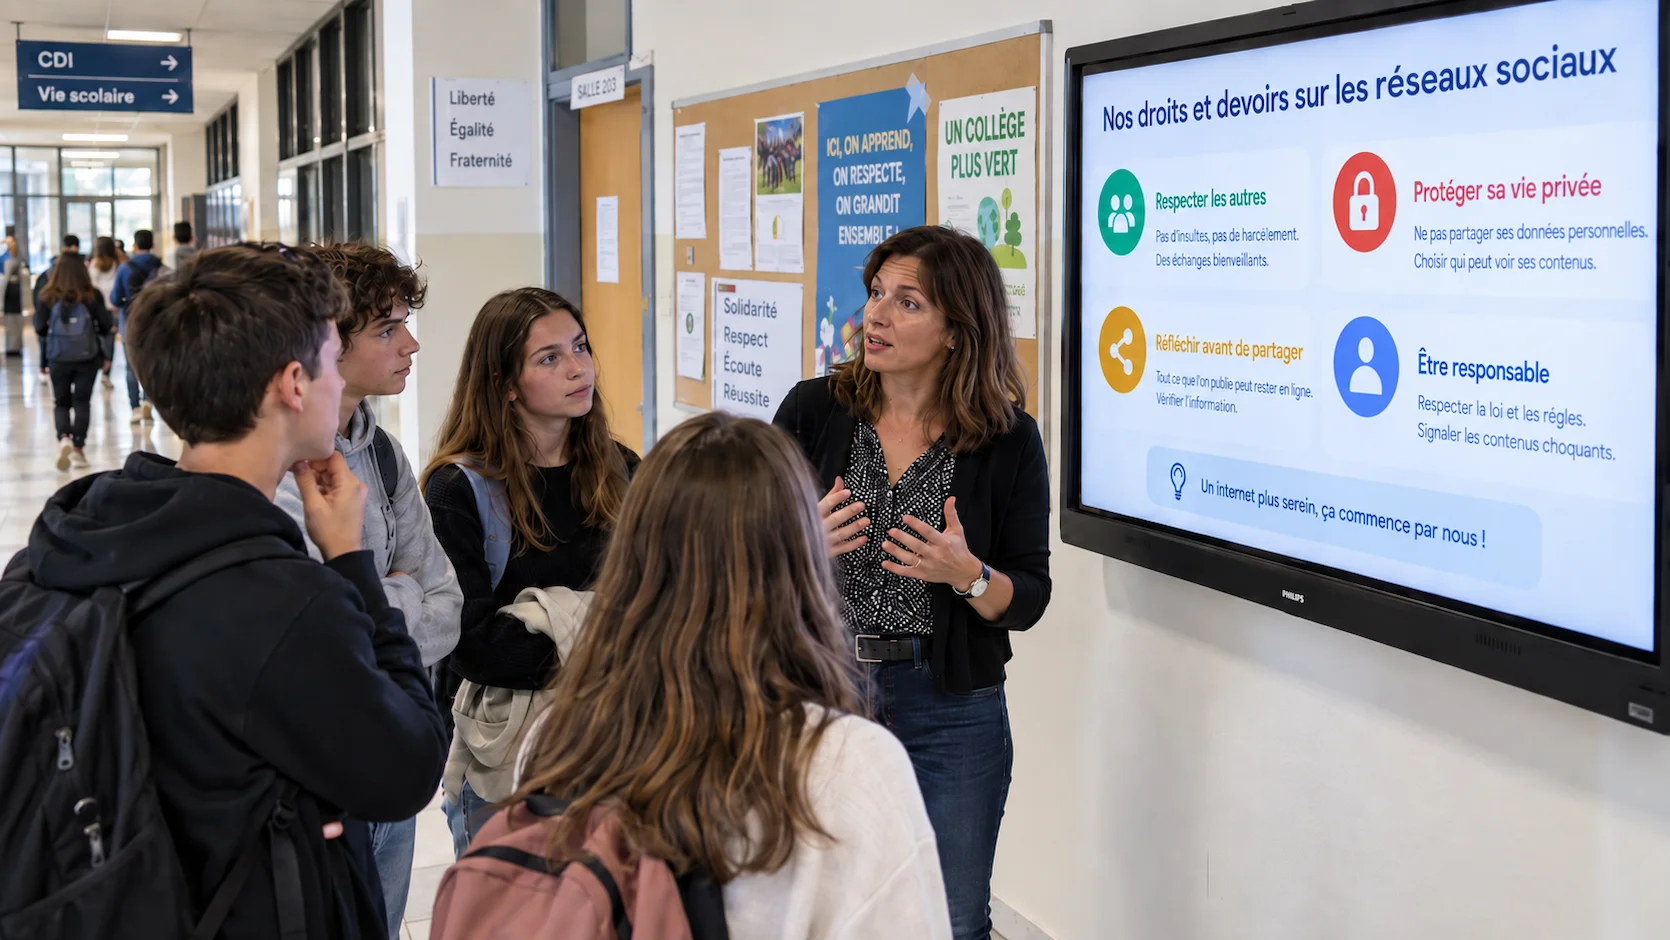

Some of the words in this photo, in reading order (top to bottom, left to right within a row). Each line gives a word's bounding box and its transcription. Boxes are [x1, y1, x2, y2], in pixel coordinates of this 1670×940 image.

[37, 51, 73, 69] CDI
[37, 86, 66, 103] Vie
[70, 87, 135, 104] scolaire
[449, 90, 495, 106] Liberté
[578, 80, 600, 99] SALLE
[602, 77, 617, 94] 203
[1103, 105, 1133, 132] Nos
[1138, 97, 1188, 127] droits
[1193, 95, 1212, 121] et
[1216, 84, 1289, 119] devoirs
[1295, 84, 1329, 109] sur
[1336, 73, 1369, 105] les
[1375, 64, 1488, 100] réseaux
[1496, 43, 1617, 85] sociaux
[449, 118, 494, 140] Égalité
[945, 119, 963, 145] UN
[965, 107, 1026, 143] COLLÈGE
[826, 137, 842, 159] ICI,
[844, 134, 861, 155] ON
[861, 128, 914, 153] APPREND,
[449, 152, 513, 168] Fraternité
[951, 152, 982, 179] PLUS
[984, 148, 1018, 177] VERT
[833, 167, 848, 186] ON
[850, 161, 906, 185] RESPECTE,
[1155, 191, 1208, 213] Respecter
[1211, 188, 1227, 207] les
[1229, 188, 1267, 206] autres
[1414, 179, 1482, 208] Protéger
[1487, 183, 1506, 200] sa
[1511, 176, 1537, 199] vie
[1541, 172, 1602, 205] privée
[836, 196, 852, 215] ON
[853, 194, 901, 214] GRANDIT
[1155, 229, 1170, 243] Pas
[1212, 231, 1228, 246] pas
[1229, 227, 1241, 242] de
[1414, 225, 1428, 241] Ne
[1430, 228, 1447, 245] pas
[1449, 226, 1494, 245] partager
[1496, 228, 1514, 240] ses
[1516, 222, 1566, 240] données
[1568, 220, 1649, 244] personnelles.
[1155, 253, 1171, 267] Des
[1172, 252, 1212, 270] échanges
[1213, 252, 1270, 267] bienveillants.
[1414, 252, 1448, 269] Choisir
[1450, 252, 1466, 273] qui
[1468, 254, 1492, 273] peut
[1495, 253, 1515, 269] voir
[1517, 256, 1537, 270] ses
[1539, 254, 1597, 270] contenus.
[723, 297, 778, 319] Solidarité
[723, 326, 769, 348] Respect
[1155, 333, 1201, 353] Réfléchir
[1202, 339, 1233, 356] avant
[1235, 338, 1250, 357] de
[1251, 342, 1304, 365] partager
[723, 351, 763, 377] Écoute
[1418, 347, 1448, 377] Être
[1452, 360, 1550, 385] responsable
[723, 382, 770, 408] Réussite
[1155, 370, 1172, 385] Tout
[1172, 375, 1181, 385] ce
[1181, 376, 1196, 389] que
[1210, 376, 1234, 392] publie
[1234, 380, 1253, 394] peut
[1254, 381, 1278, 395] rester
[1279, 384, 1291, 396] en
[1291, 382, 1314, 401] ligne.
[1155, 391, 1184, 408] Vérifier
[1418, 394, 1473, 416] Respecter
[1476, 399, 1487, 417] la
[1489, 401, 1503, 419] loi
[1506, 404, 1519, 420] et
[1522, 404, 1540, 423] les
[1417, 421, 1462, 444] Signaler
[1464, 427, 1480, 445] les
[1483, 433, 1539, 452] contenus
[1542, 437, 1616, 461] choquants.
[1201, 478, 1214, 495] Un
[1216, 481, 1256, 504] internet
[1258, 489, 1280, 509] plus
[1282, 496, 1319, 518] serein,
[1321, 502, 1336, 522] ça
[1338, 507, 1411, 534] commence
[1414, 520, 1438, 541] par
[1442, 528, 1478, 548] nous
[1481, 528, 1487, 549] !
